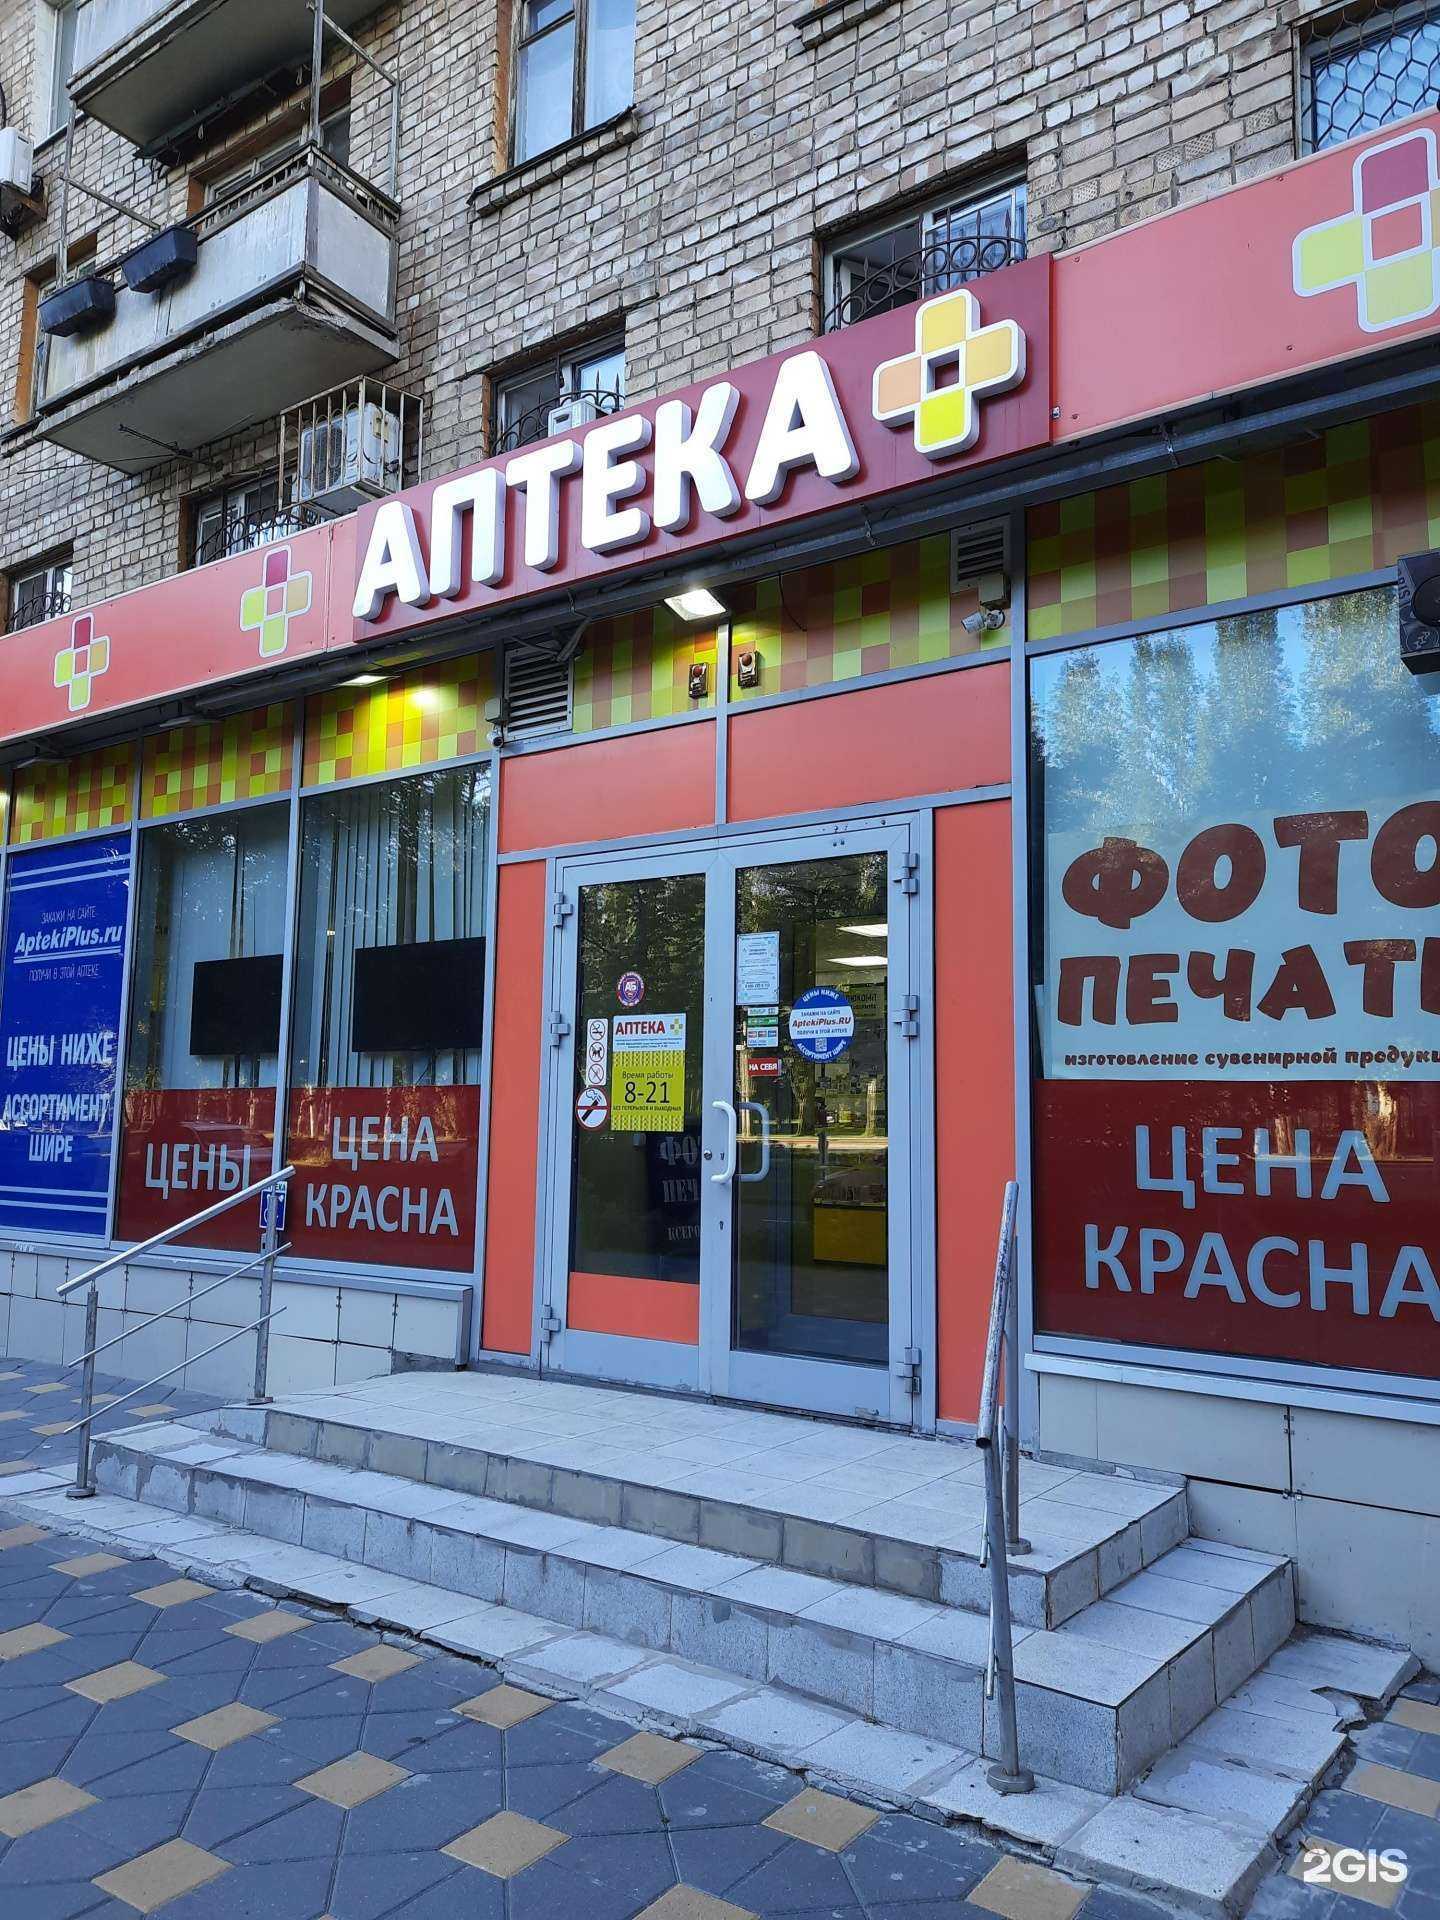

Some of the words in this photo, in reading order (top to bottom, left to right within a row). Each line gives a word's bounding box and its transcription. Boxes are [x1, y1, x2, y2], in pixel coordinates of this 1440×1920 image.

[353, 351, 859, 622] АПТЕКА
[1062, 801, 1440, 929] ФОТО
[42, 910, 65, 924] ЗАКАЖИ
[67, 908, 76, 921] НА
[78, 905, 96, 919] САЙТЕ
[15, 926, 122, 957] AptekiPlus.ru
[77, 963, 99, 977] АПТЕКЕ
[802, 989, 820, 1002] ЦЕНЫ
[821, 989, 839, 1000] НИЖЕ
[615, 1020, 666, 1035] АПТЕКА
[792, 1017, 852, 1028] AptekiPlus.RU
[7, 1035, 54, 1071] ЦЕНЫ
[61, 1030, 114, 1065] НИЖЕ
[1065, 1053, 1199, 1066] изготовление
[1205, 1048, 1337, 1069] сувенирной
[623, 1071, 644, 1080] Время
[646, 1071, 673, 1080] работы
[625, 1081, 669, 1103] 8-21
[3, 1094, 111, 1121] АССОРТИМЕНТ
[29, 1134, 74, 1163] ШИРЕ
[333, 1116, 439, 1171] ЦЕНА
[660, 1136, 700, 1166] ФО
[145, 1143, 250, 1199] ЦЕНЫ
[1136, 1125, 1391, 1209] ЦЕНА
[306, 1183, 459, 1236] КРАСНА
[1084, 1223, 1440, 1322] КРАСНА
